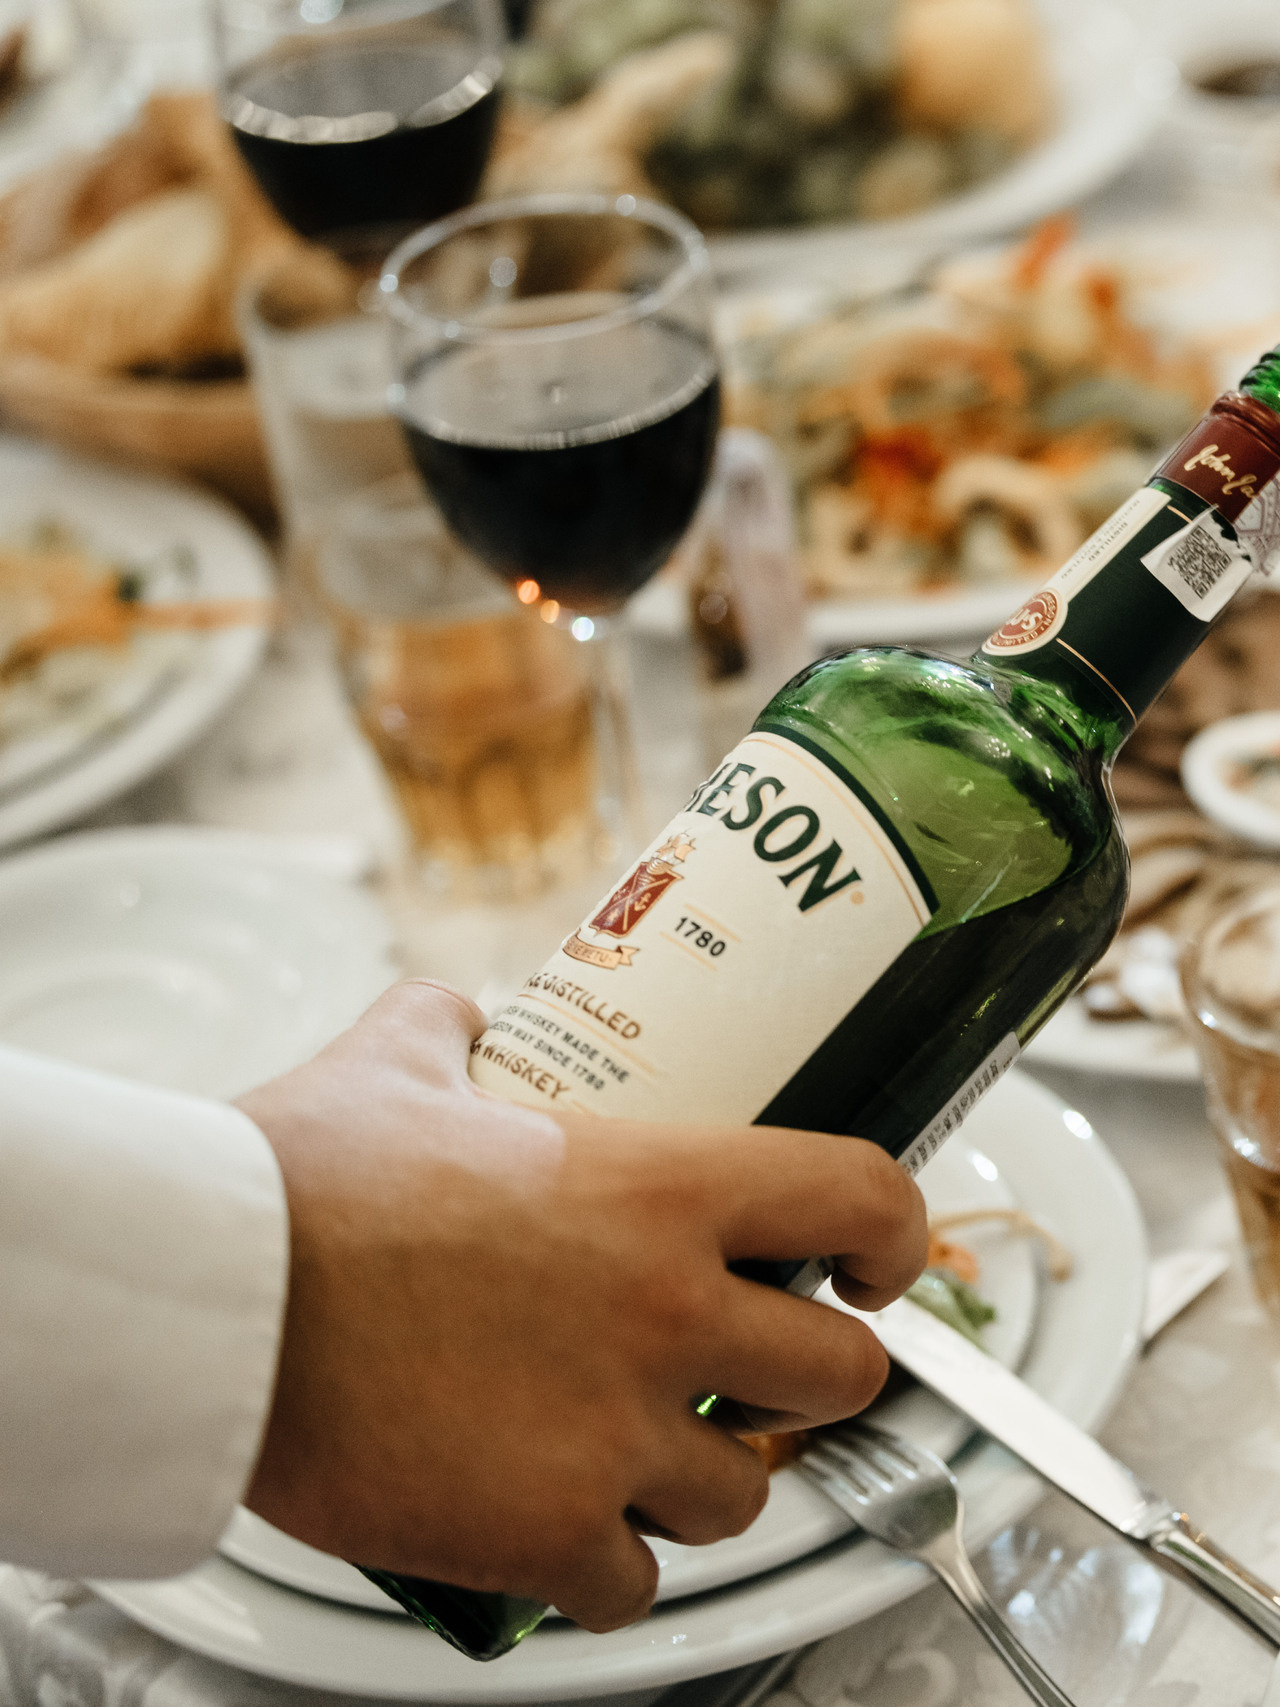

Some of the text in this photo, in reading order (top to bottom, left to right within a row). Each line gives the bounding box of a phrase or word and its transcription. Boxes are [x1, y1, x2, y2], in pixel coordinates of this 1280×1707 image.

[1222, 473, 1258, 498] Ja
[674, 917, 726, 957] 1780
[542, 975, 641, 1040] DISTILLED
[482, 1041, 571, 1100] WHISKEY
[513, 1028, 535, 1044] WAY
[533, 1038, 573, 1068] SINCE
[572, 1063, 606, 1091] 1780
[517, 1008, 563, 1036] WHISKEY
[561, 1032, 600, 1061] MADE
[600, 1056, 630, 1084] THE
